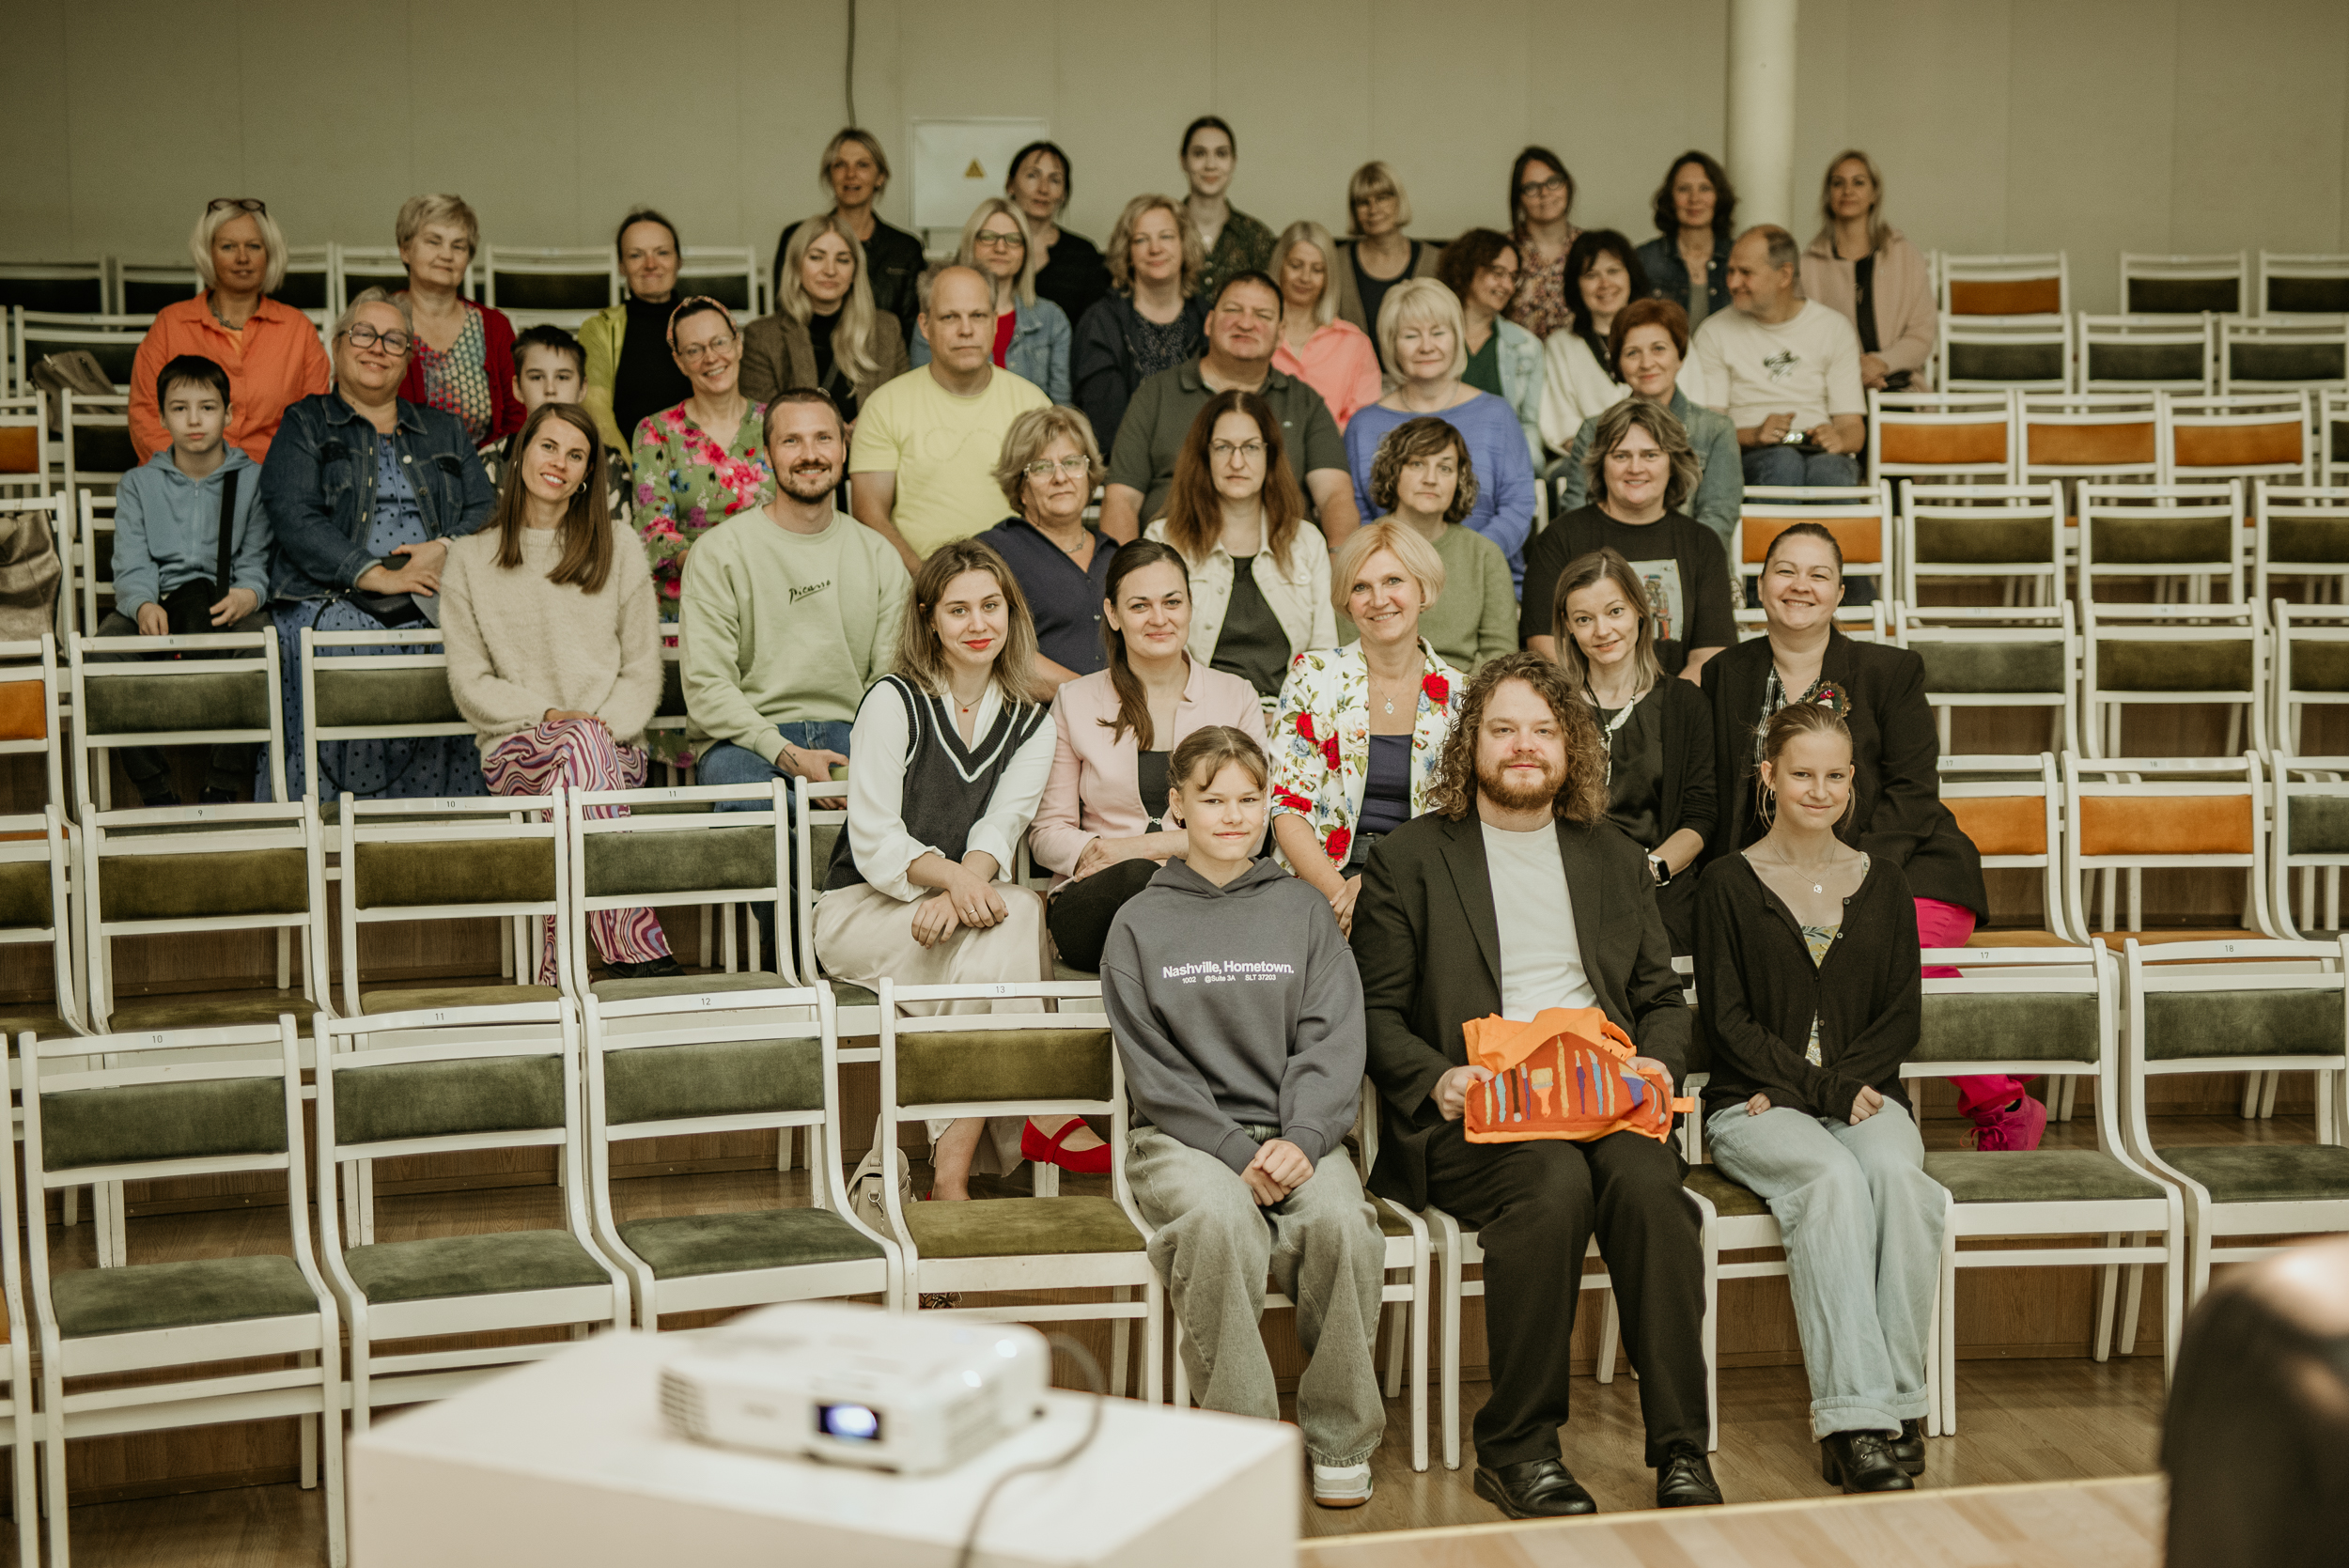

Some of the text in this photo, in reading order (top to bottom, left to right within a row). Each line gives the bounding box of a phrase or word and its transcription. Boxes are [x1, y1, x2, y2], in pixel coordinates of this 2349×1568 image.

[1162, 960, 1295, 978] Nashville, Hometown.
[1204, 974, 1226, 983] @Suite
[996, 986, 1005, 994] 13
[701, 998, 711, 1006] 12
[435, 1013, 444, 1021] 11
[152, 1035, 163, 1044] 10
